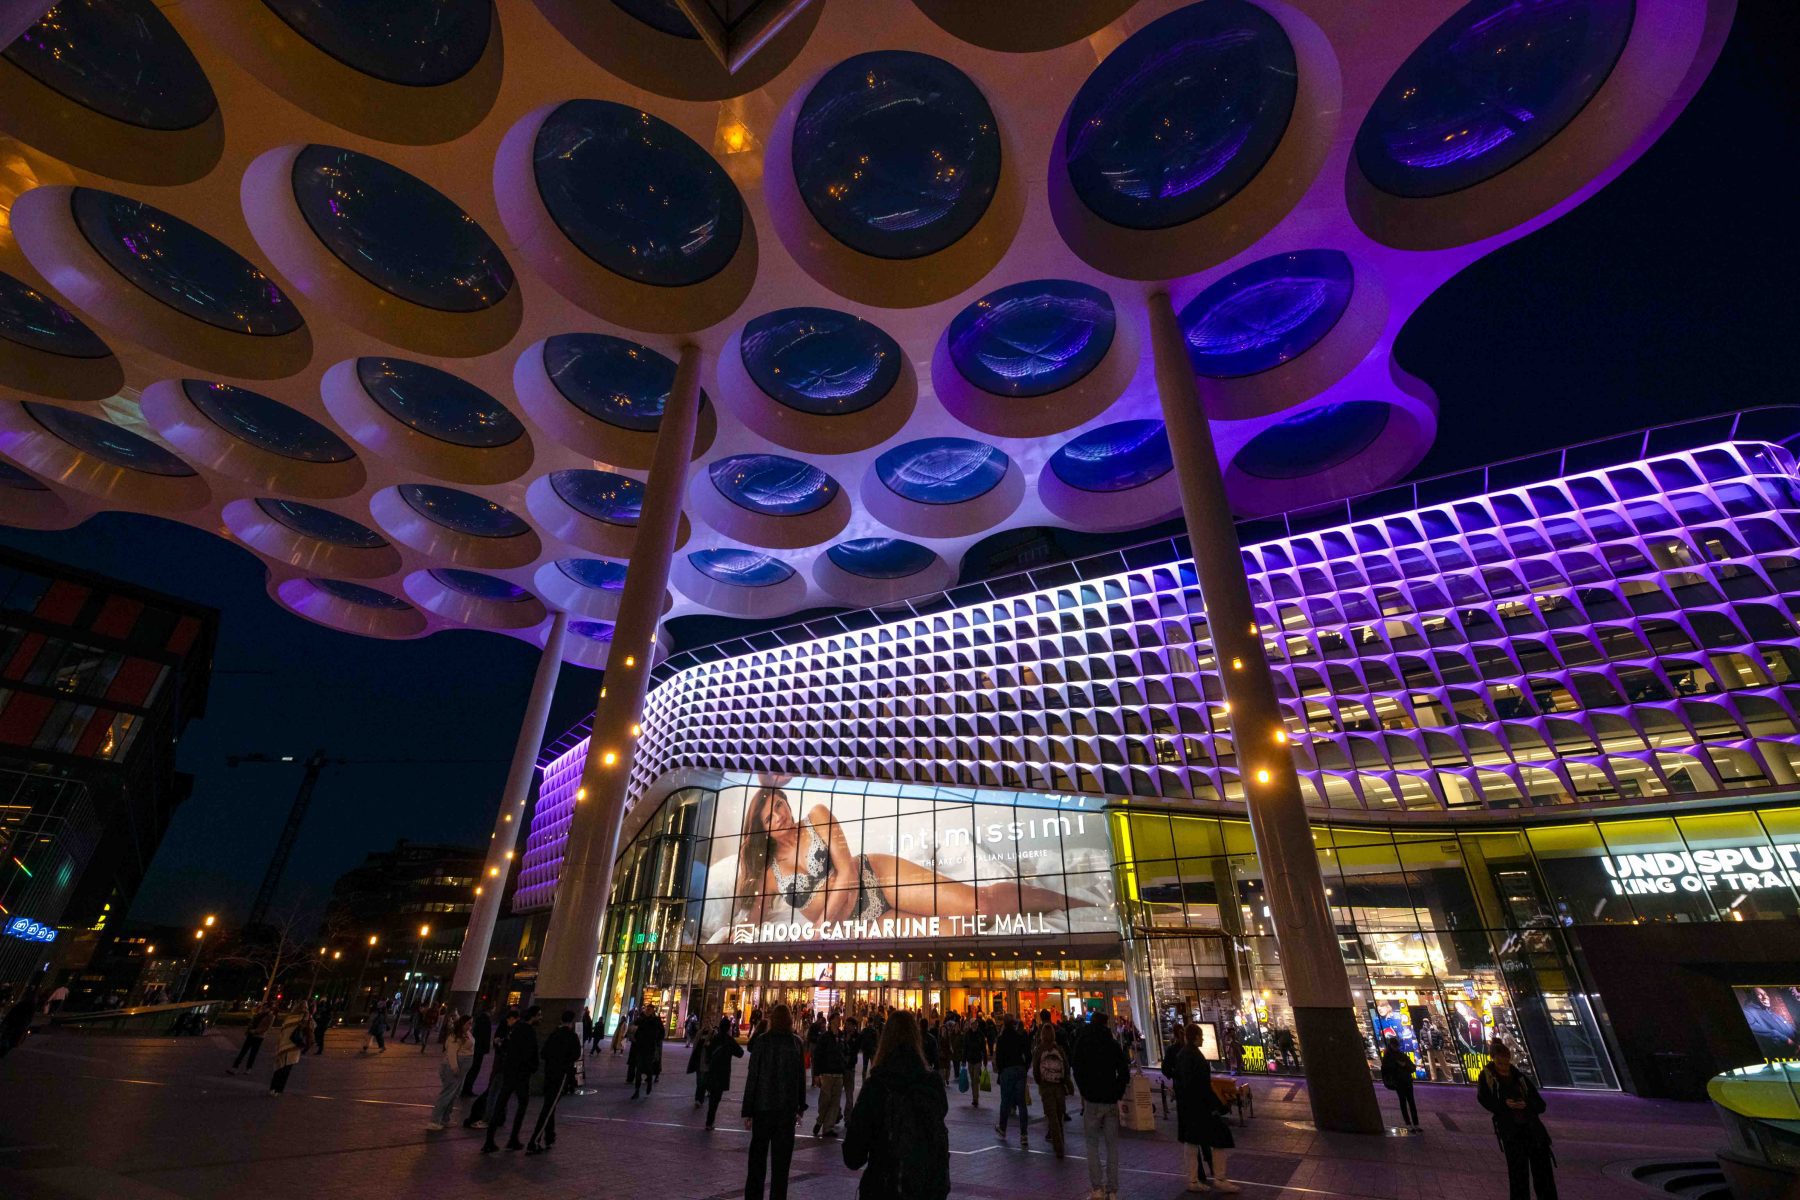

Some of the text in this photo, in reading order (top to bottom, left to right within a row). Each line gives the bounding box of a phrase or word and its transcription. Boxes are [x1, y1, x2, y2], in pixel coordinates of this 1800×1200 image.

[889, 814, 1085, 853] intimissimi
[1007, 849, 1048, 860] LINGERIE
[1611, 877, 1676, 896] KING
[1680, 872, 1717, 892] OF
[762, 911, 1051, 942] HOOG CATHARIJNE THE MALL
